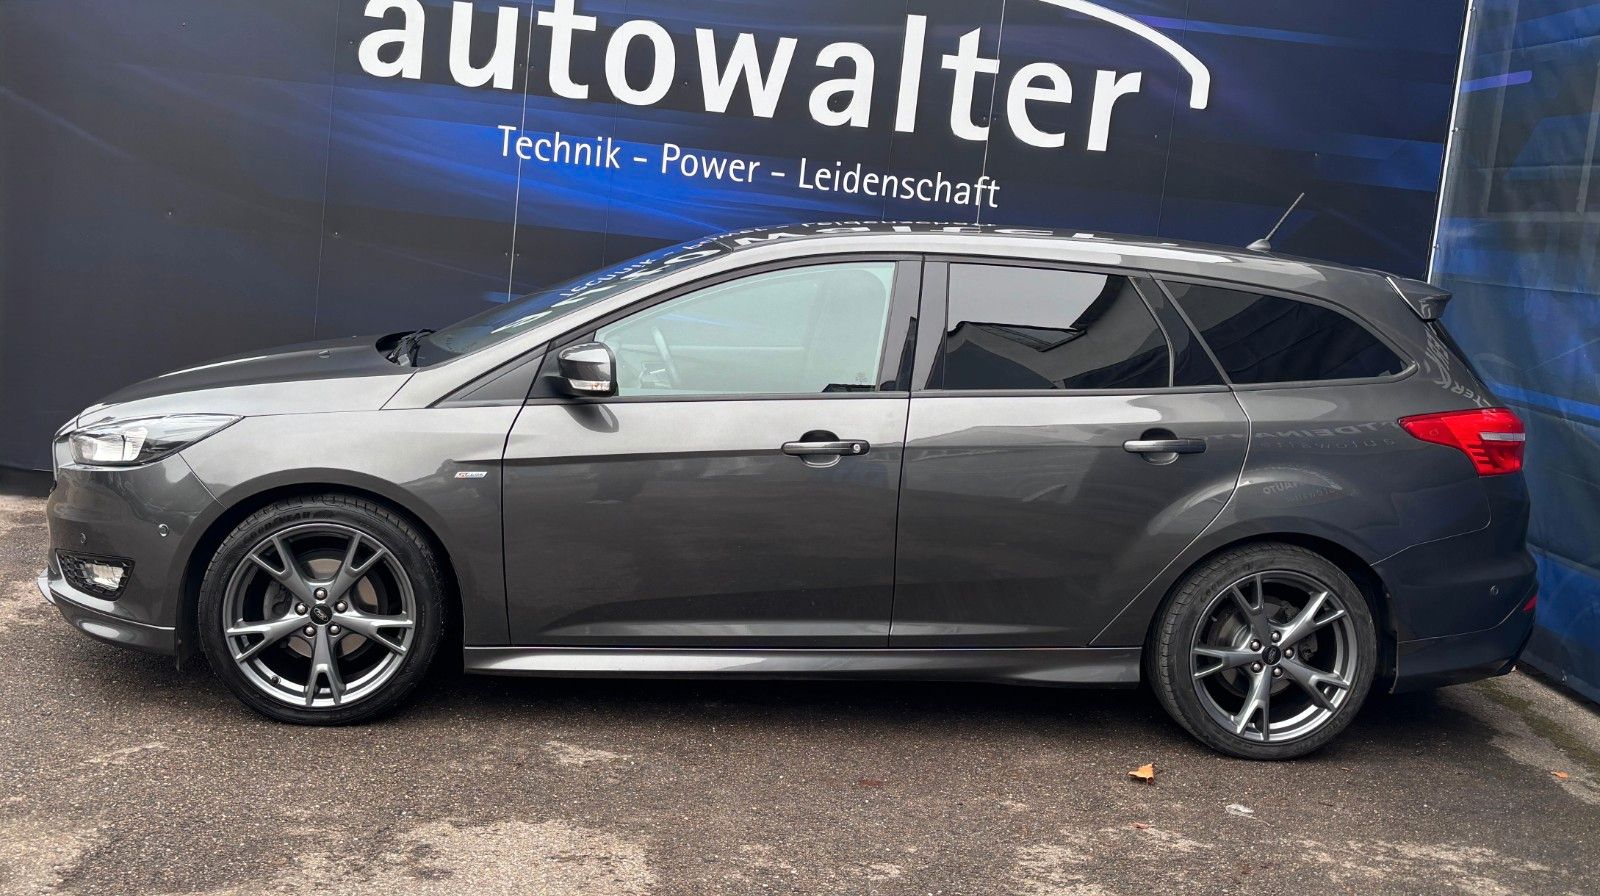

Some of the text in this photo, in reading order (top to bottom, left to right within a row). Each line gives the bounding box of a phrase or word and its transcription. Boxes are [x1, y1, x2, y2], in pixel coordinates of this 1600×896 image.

[357, 0, 1142, 152] autowalter
[497, 124, 621, 169] Technik
[661, 142, 761, 184] Power
[798, 157, 1001, 209] Leidenschaft
